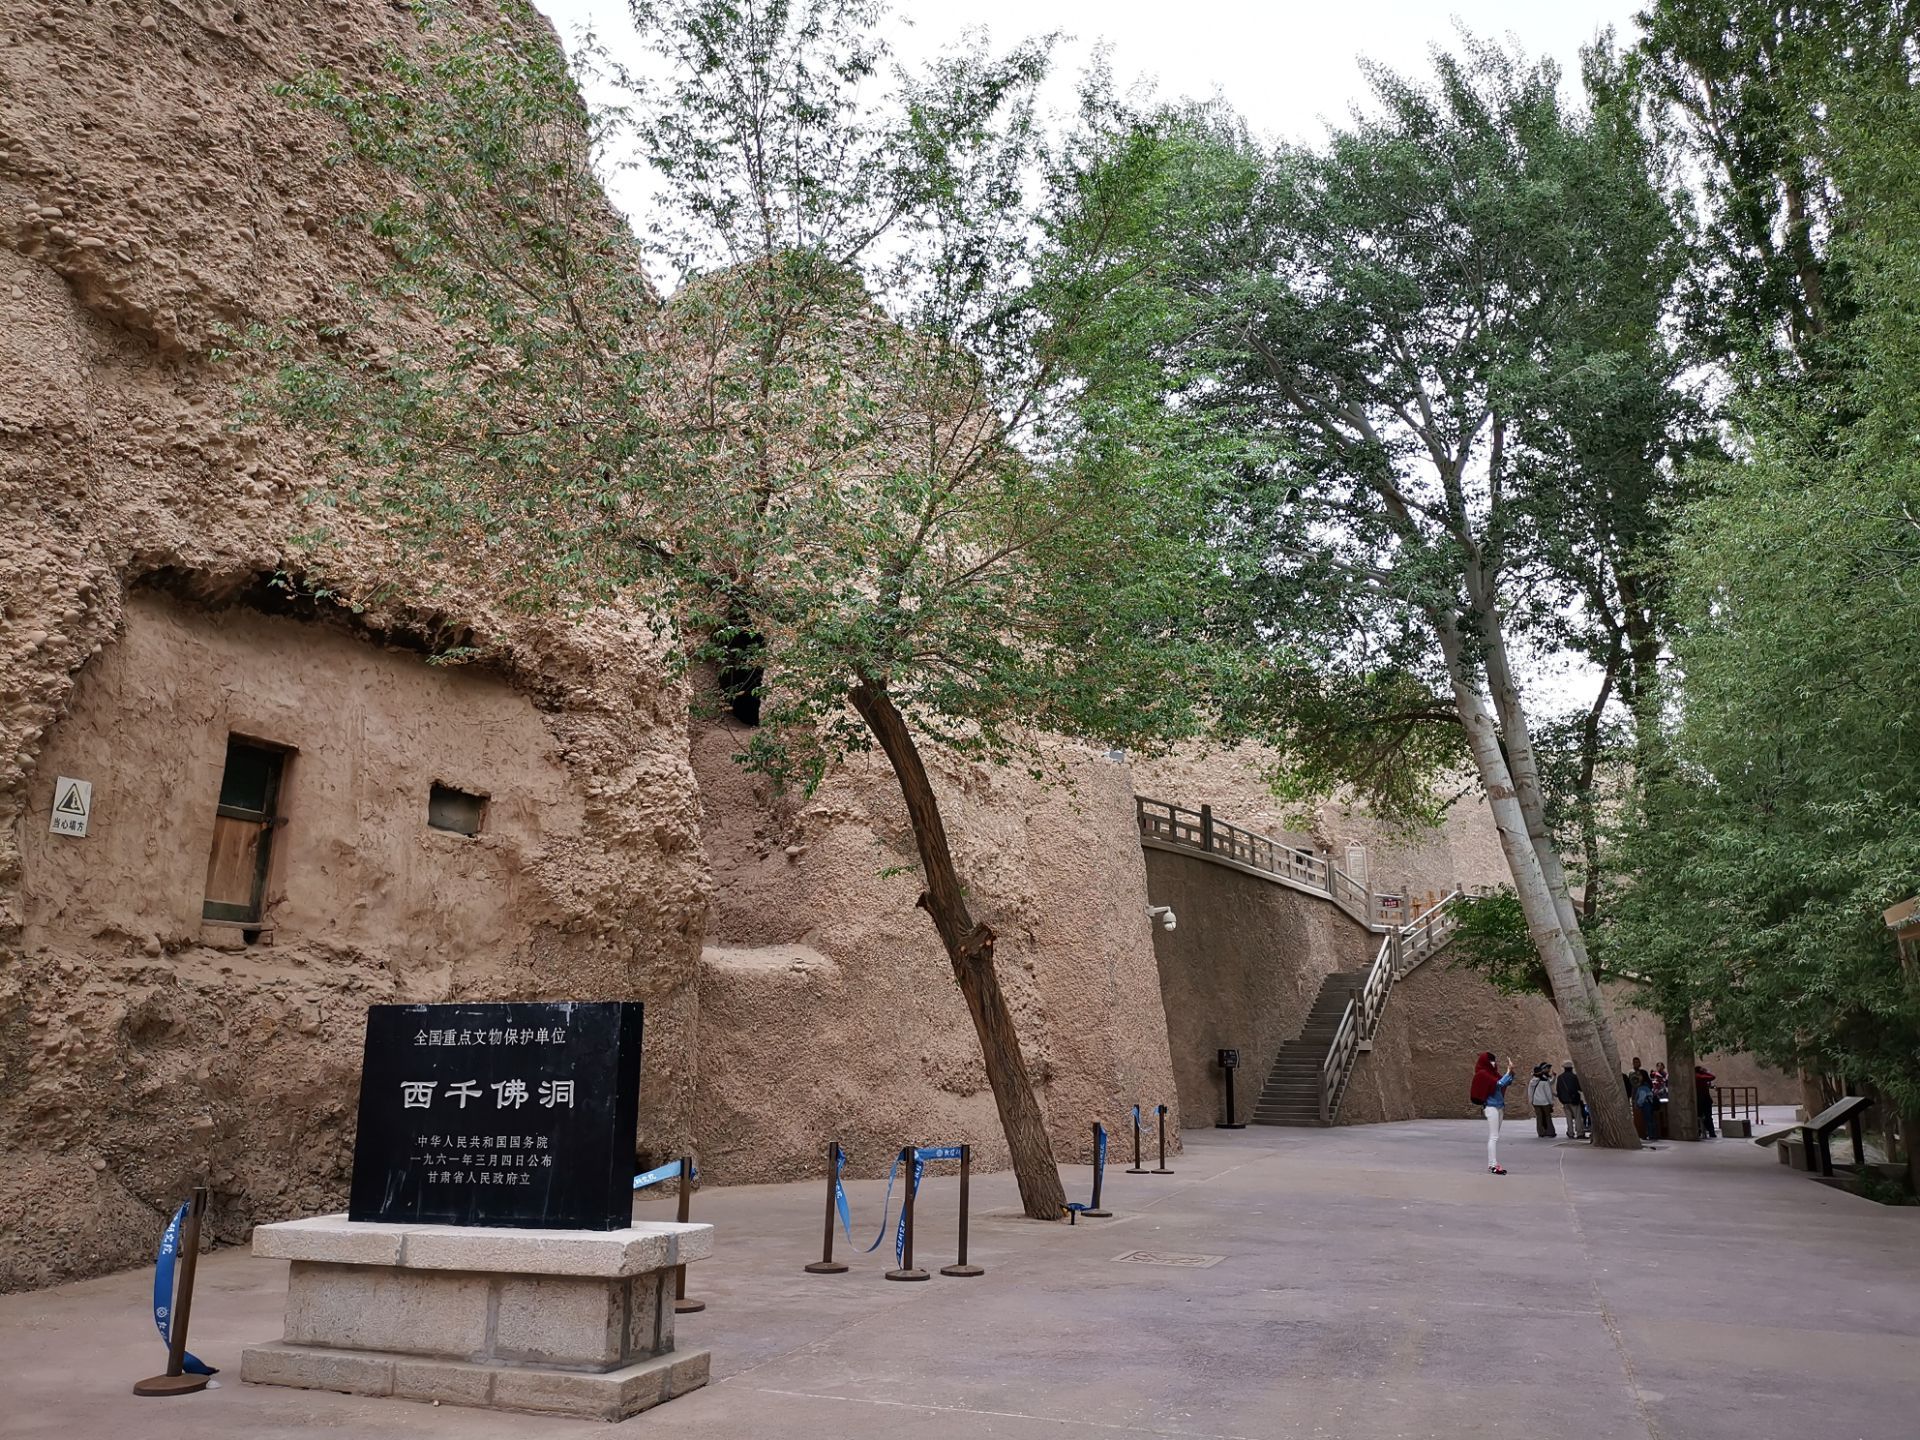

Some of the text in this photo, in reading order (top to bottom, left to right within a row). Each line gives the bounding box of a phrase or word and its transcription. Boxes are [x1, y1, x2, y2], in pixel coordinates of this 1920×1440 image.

[413, 1027, 567, 1046] 全国重点文物保护单位
[400, 1078, 575, 1110] 西千佛洞
[418, 1135, 549, 1149] 中华人民共和国国务院
[410, 1153, 553, 1168] 一九六一年三月四日公布
[427, 1171, 531, 1185] 甘肃省人民政府立
